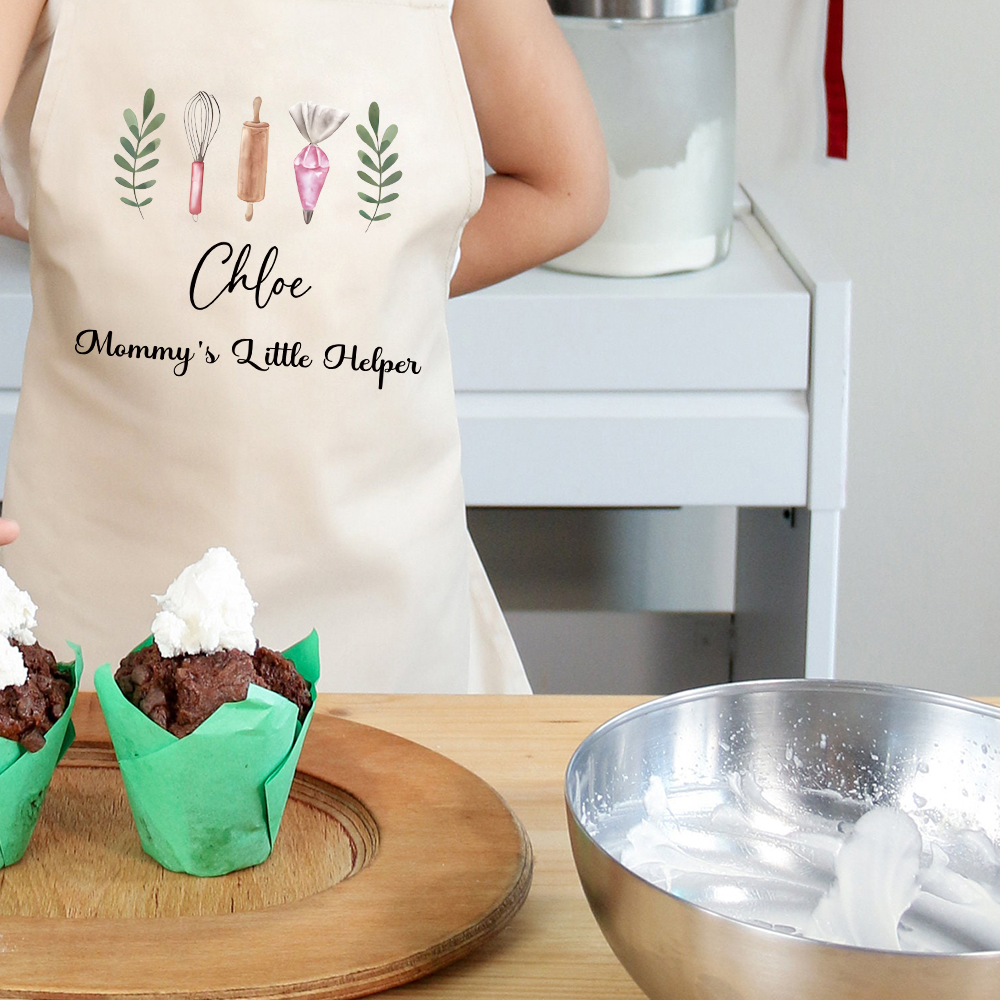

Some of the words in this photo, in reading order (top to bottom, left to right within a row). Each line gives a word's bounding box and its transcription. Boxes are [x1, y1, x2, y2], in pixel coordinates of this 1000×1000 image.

[189, 241, 313, 311] Chloe
[74, 329, 221, 377] Mommy's
[231, 338, 313, 372] Little
[323, 343, 422, 390] Helper
